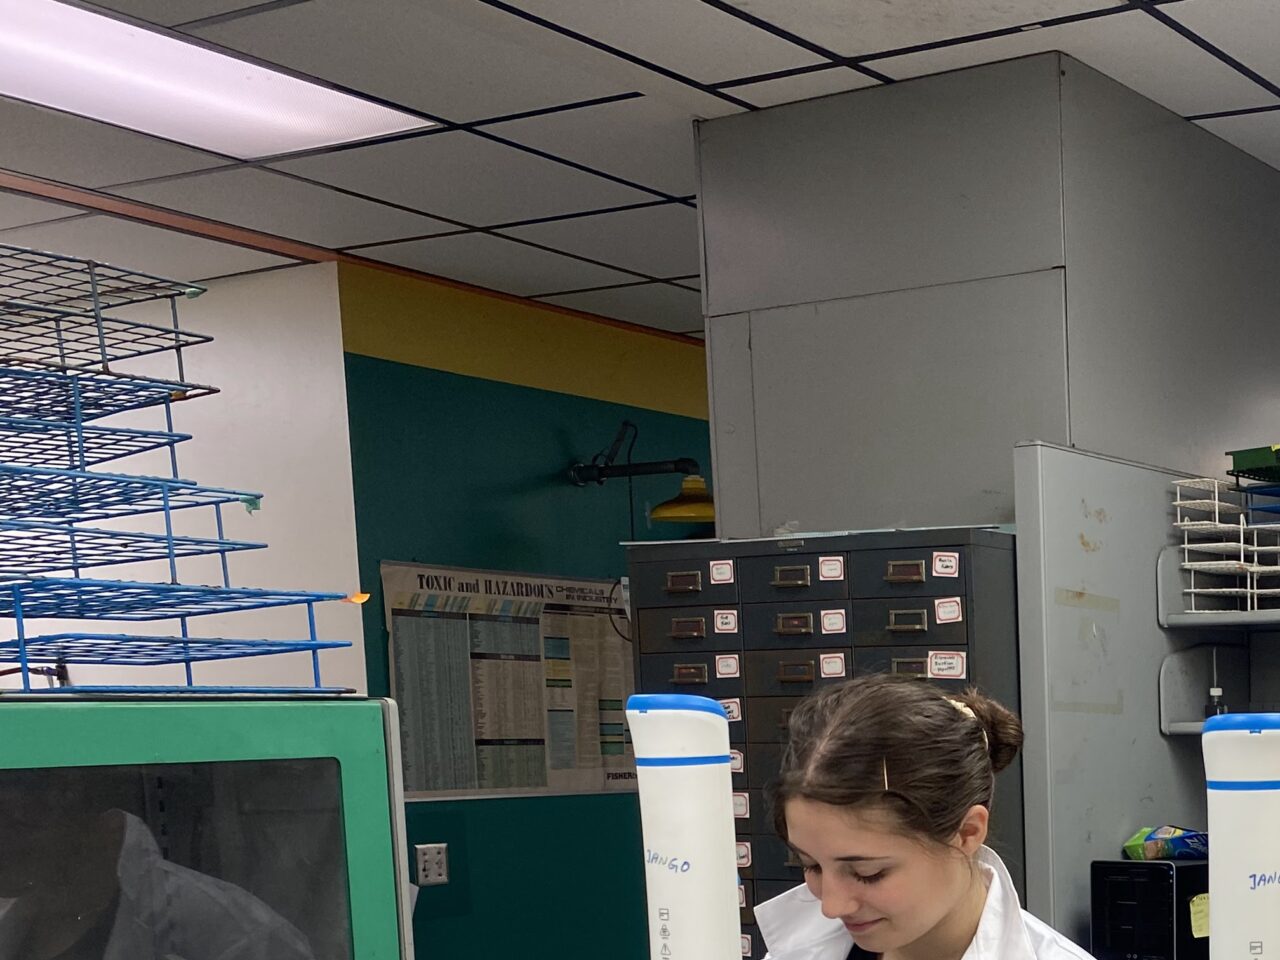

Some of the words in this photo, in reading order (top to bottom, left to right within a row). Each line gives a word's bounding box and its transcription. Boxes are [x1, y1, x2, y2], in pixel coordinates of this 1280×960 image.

[417, 574, 454, 592] TOXIC
[457, 578, 480, 594] and
[484, 579, 554, 599] HAZARDOUS
[646, 849, 690, 873] JANGO
